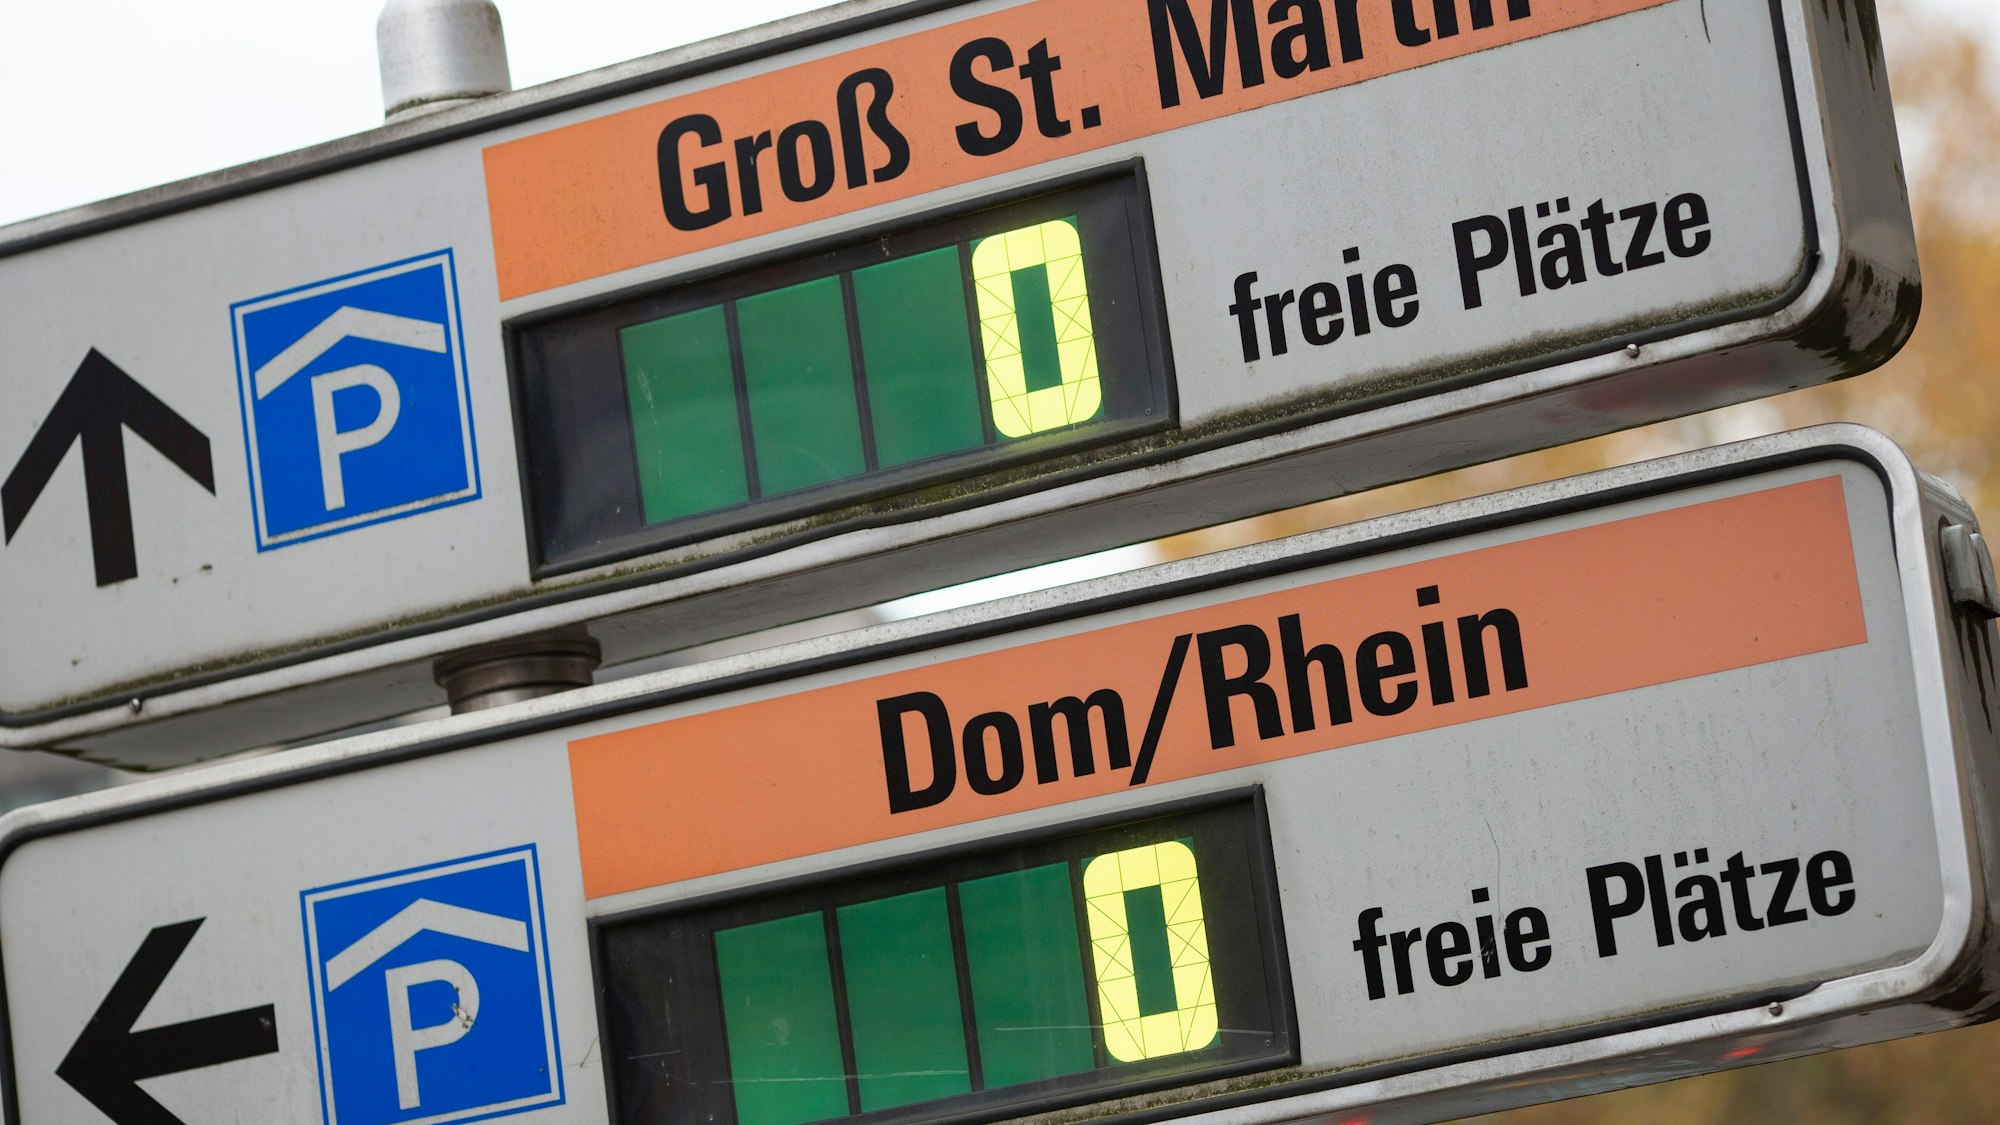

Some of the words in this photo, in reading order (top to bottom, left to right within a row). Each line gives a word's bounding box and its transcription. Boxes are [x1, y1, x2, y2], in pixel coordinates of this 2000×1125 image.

[656, 67, 911, 232] Groß
[949, 37, 1102, 157] St.
[971, 219, 1102, 438] 0
[1228, 246, 1420, 364] freie
[1451, 192, 1712, 310] Plätze
[311, 363, 401, 511] P
[876, 584, 1529, 815] Dom/Rhein
[1083, 841, 1219, 1063] 0
[1353, 886, 1552, 1001] freie
[1586, 847, 1856, 958] Plätze
[385, 958, 480, 1111] P
